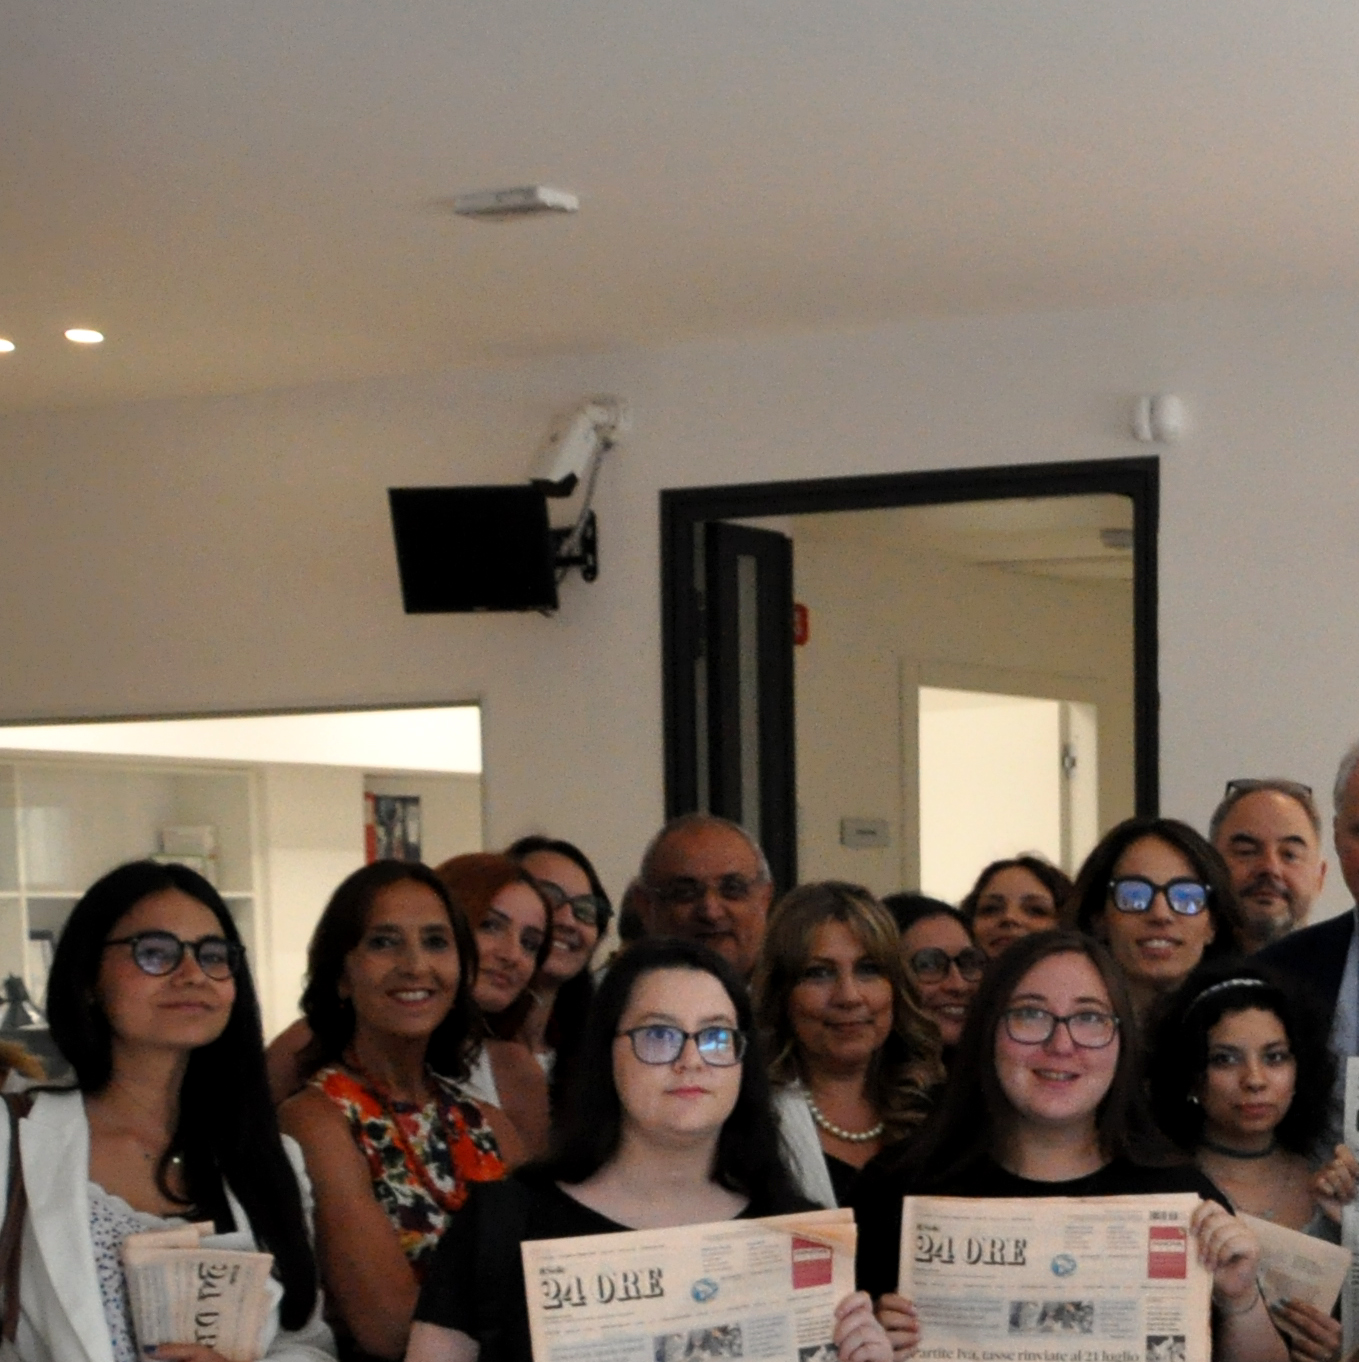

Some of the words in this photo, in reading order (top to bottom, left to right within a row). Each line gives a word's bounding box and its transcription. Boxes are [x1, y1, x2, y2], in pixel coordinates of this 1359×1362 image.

[914, 1234, 954, 1263] 24
[963, 1235, 1027, 1266] ORE
[541, 1276, 587, 1310] 24
[596, 1267, 664, 1304] ORE
